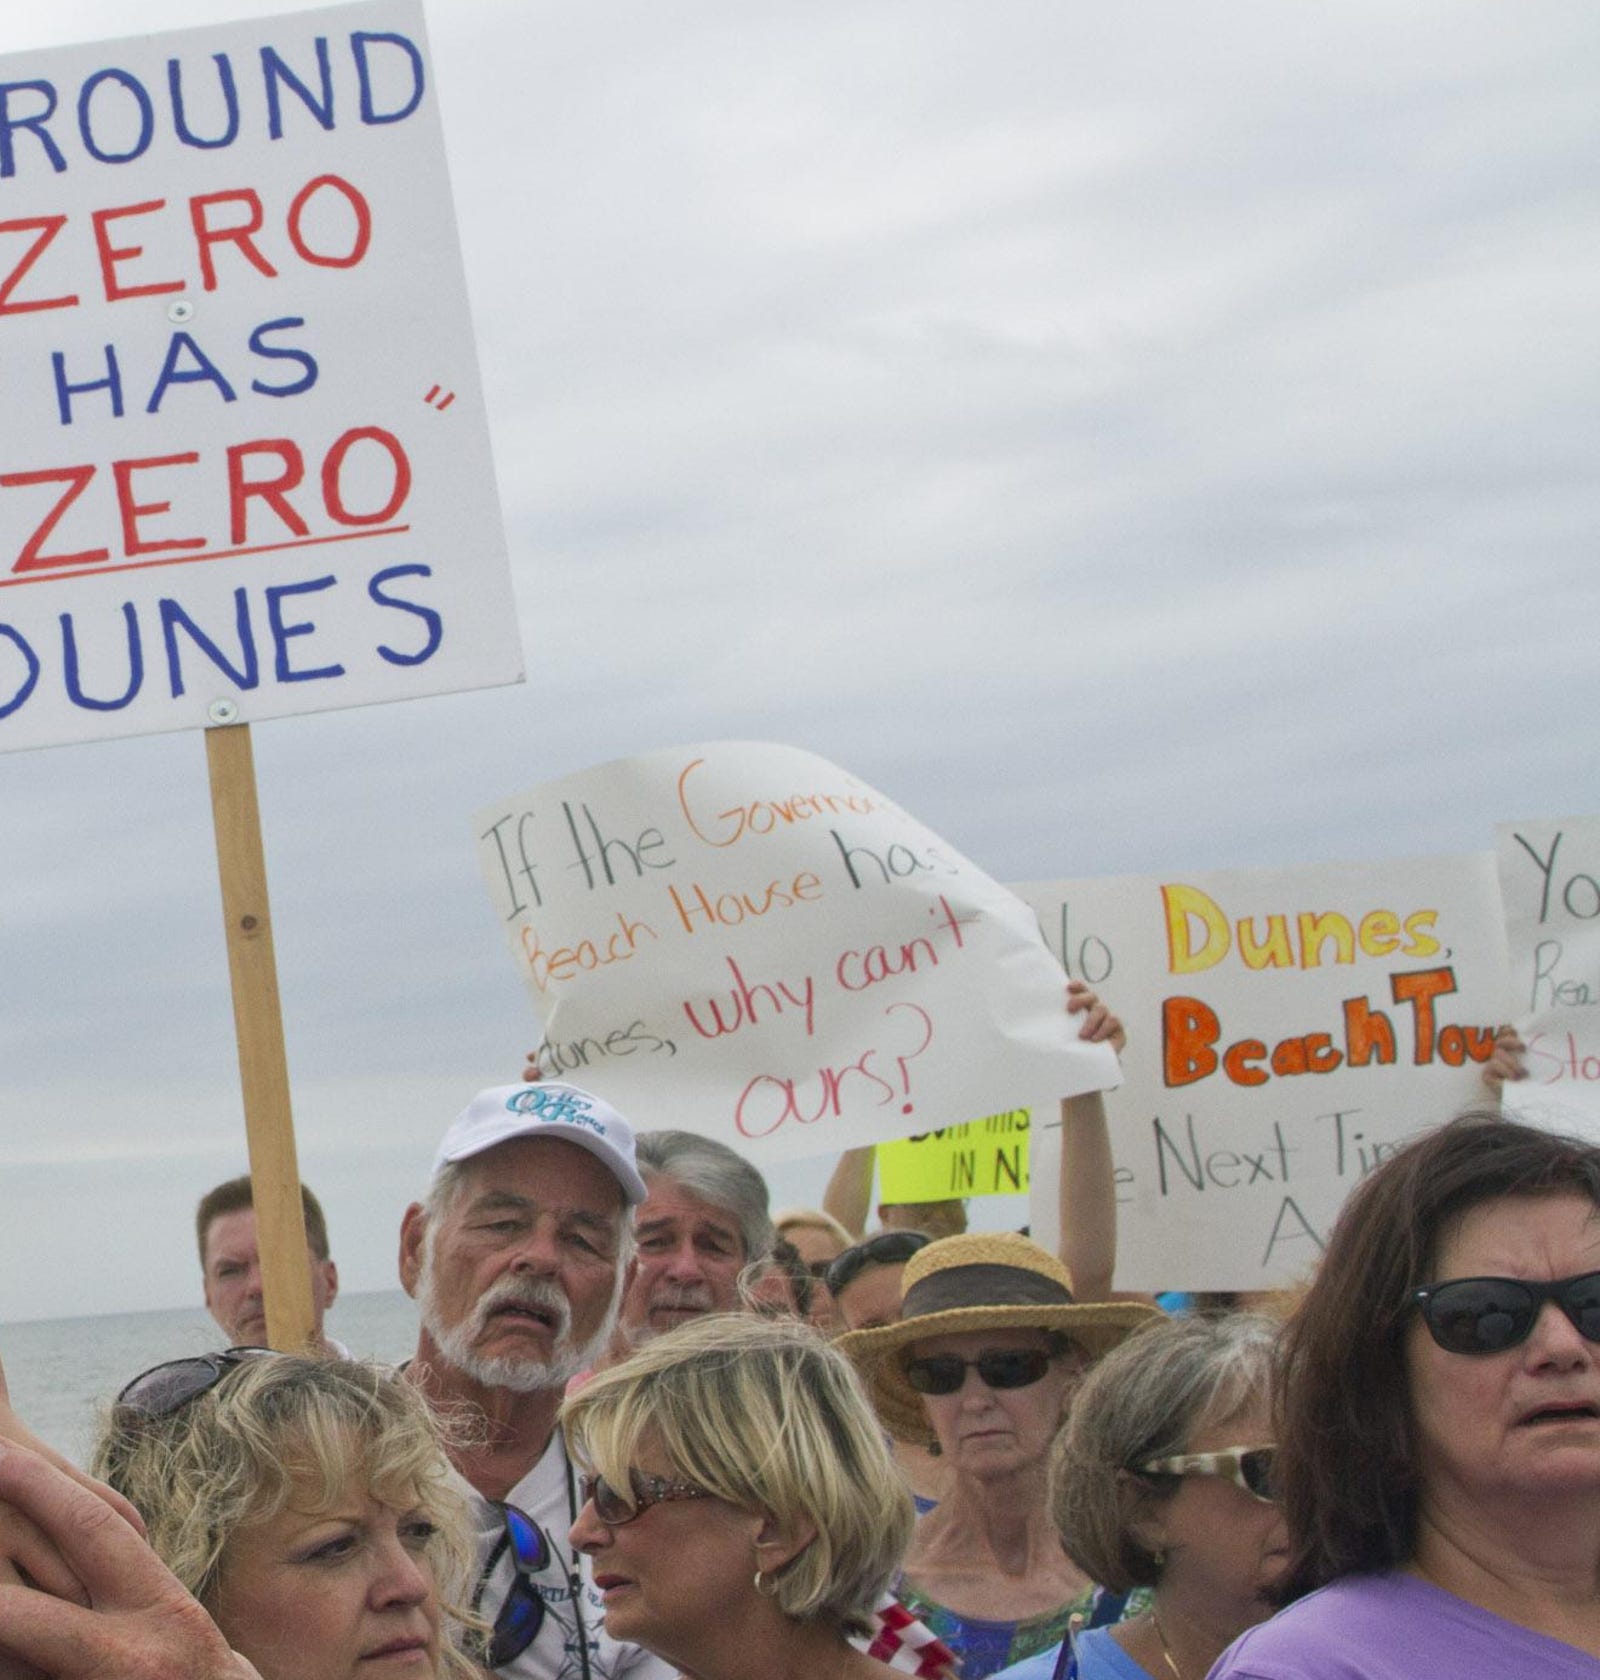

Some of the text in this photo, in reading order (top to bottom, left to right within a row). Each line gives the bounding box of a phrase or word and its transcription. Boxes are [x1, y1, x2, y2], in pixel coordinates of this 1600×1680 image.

[52, 317, 319, 425] HAS
[481, 810, 541, 921] If
[566, 802, 676, 890] the
[521, 912, 658, 993] Beach
[669, 872, 823, 933] House
[684, 955, 813, 1036] why
[837, 895, 981, 991] can't
[1160, 883, 1454, 975] Dunes,
[735, 1002, 933, 1138] ours?
[1162, 995, 1397, 1088] Beach
[950, 1150, 975, 1192] IN
[1153, 1113, 1298, 1195] Next
